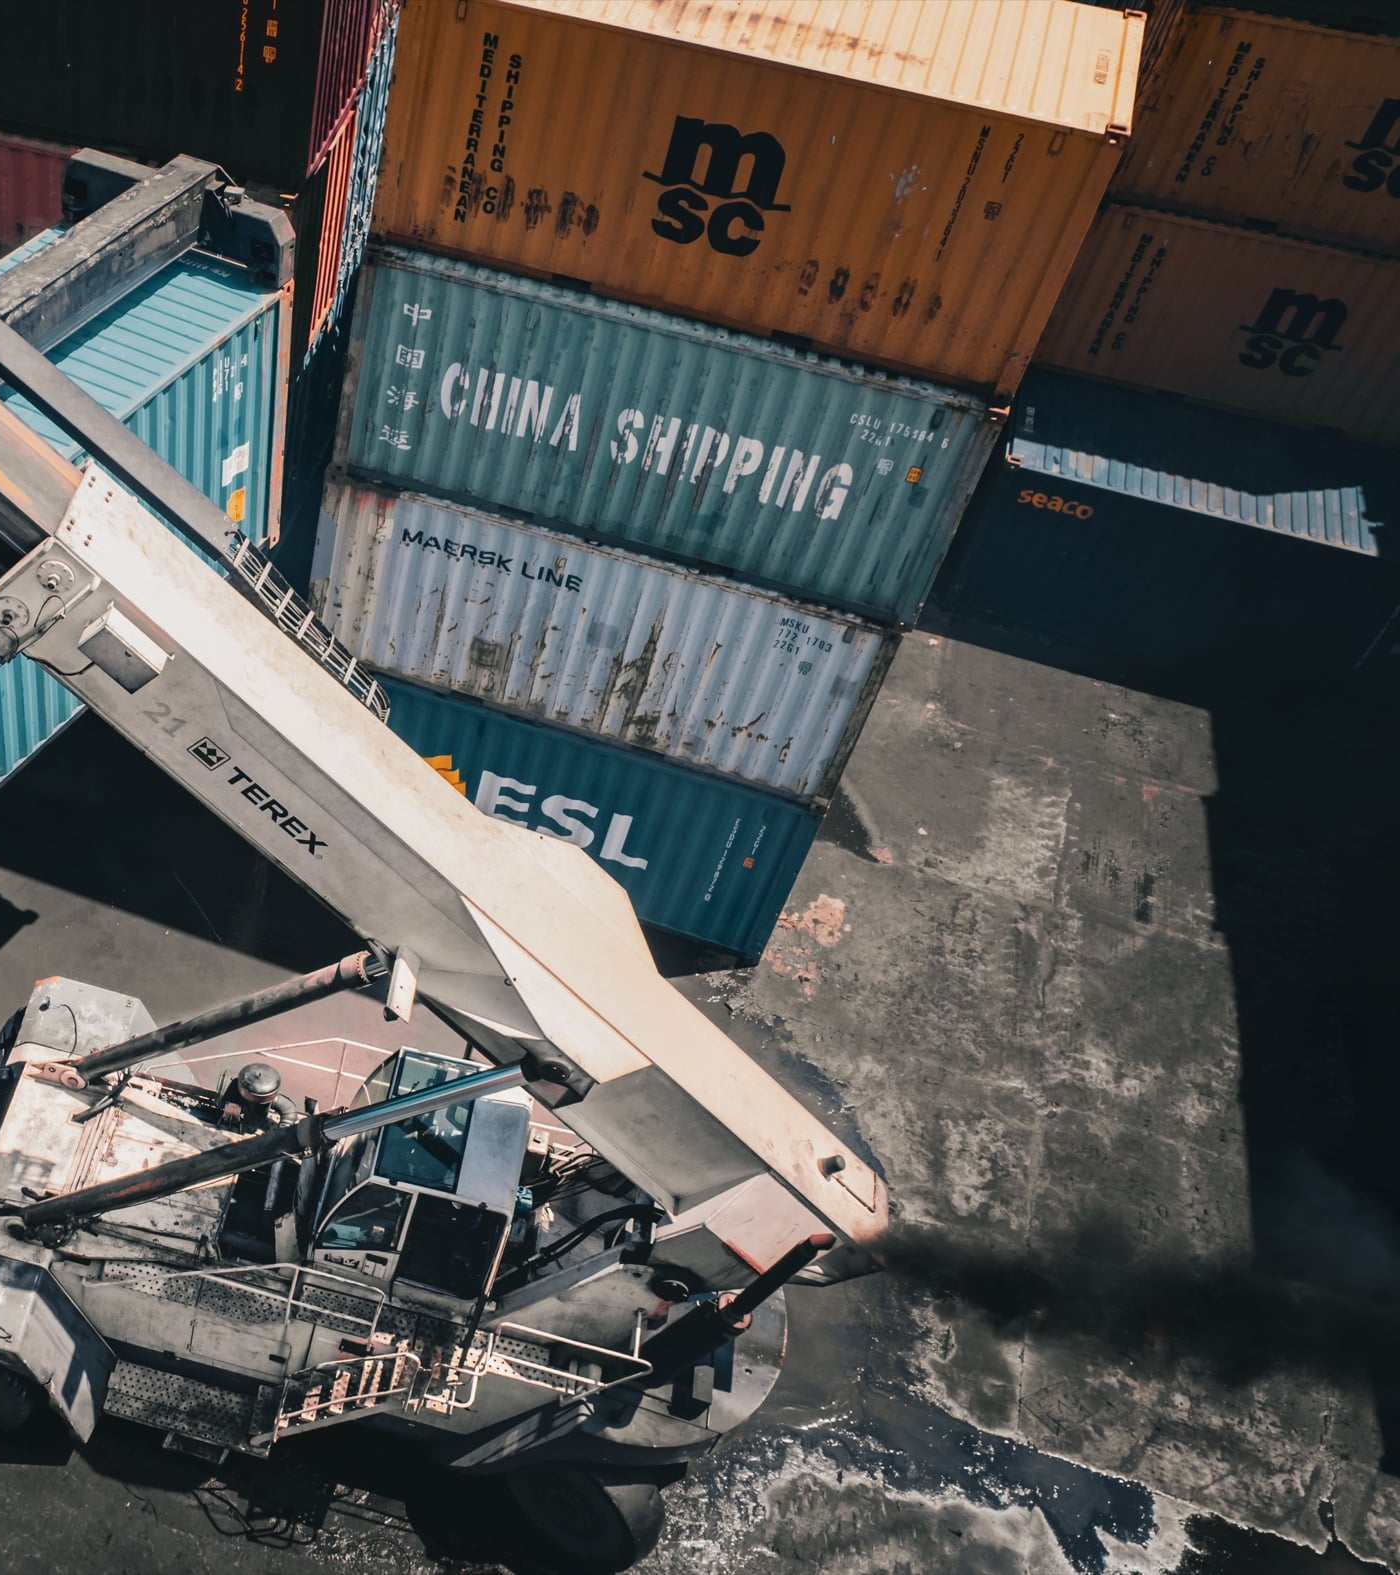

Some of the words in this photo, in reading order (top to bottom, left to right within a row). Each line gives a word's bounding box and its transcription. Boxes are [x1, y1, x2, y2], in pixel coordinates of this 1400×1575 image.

[454, 32, 499, 223] MEDITERRANEAN
[490, 54, 522, 172] SHIPPING
[1175, 41, 1253, 184] MEDITERRANEAN
[1216, 57, 1266, 146] SHIPPING
[481, 187, 498, 214] CO
[1200, 155, 1217, 176] CO
[1123, 247, 1167, 324] SHIPPING
[441, 362, 582, 451] CHINA
[610, 408, 853, 520] SHIPPING
[850, 413, 881, 430] CSLU
[941, 438, 950, 449] 6
[1017, 489, 1095, 520] seaco
[401, 528, 514, 573] MAERSK
[521, 561, 583, 593] LINE
[780, 617, 810, 634] MSKU
[806, 636, 833, 653] 1703
[142, 702, 188, 738] 21
[227, 766, 329, 856] TEREX
[474, 770, 648, 871] ESL
